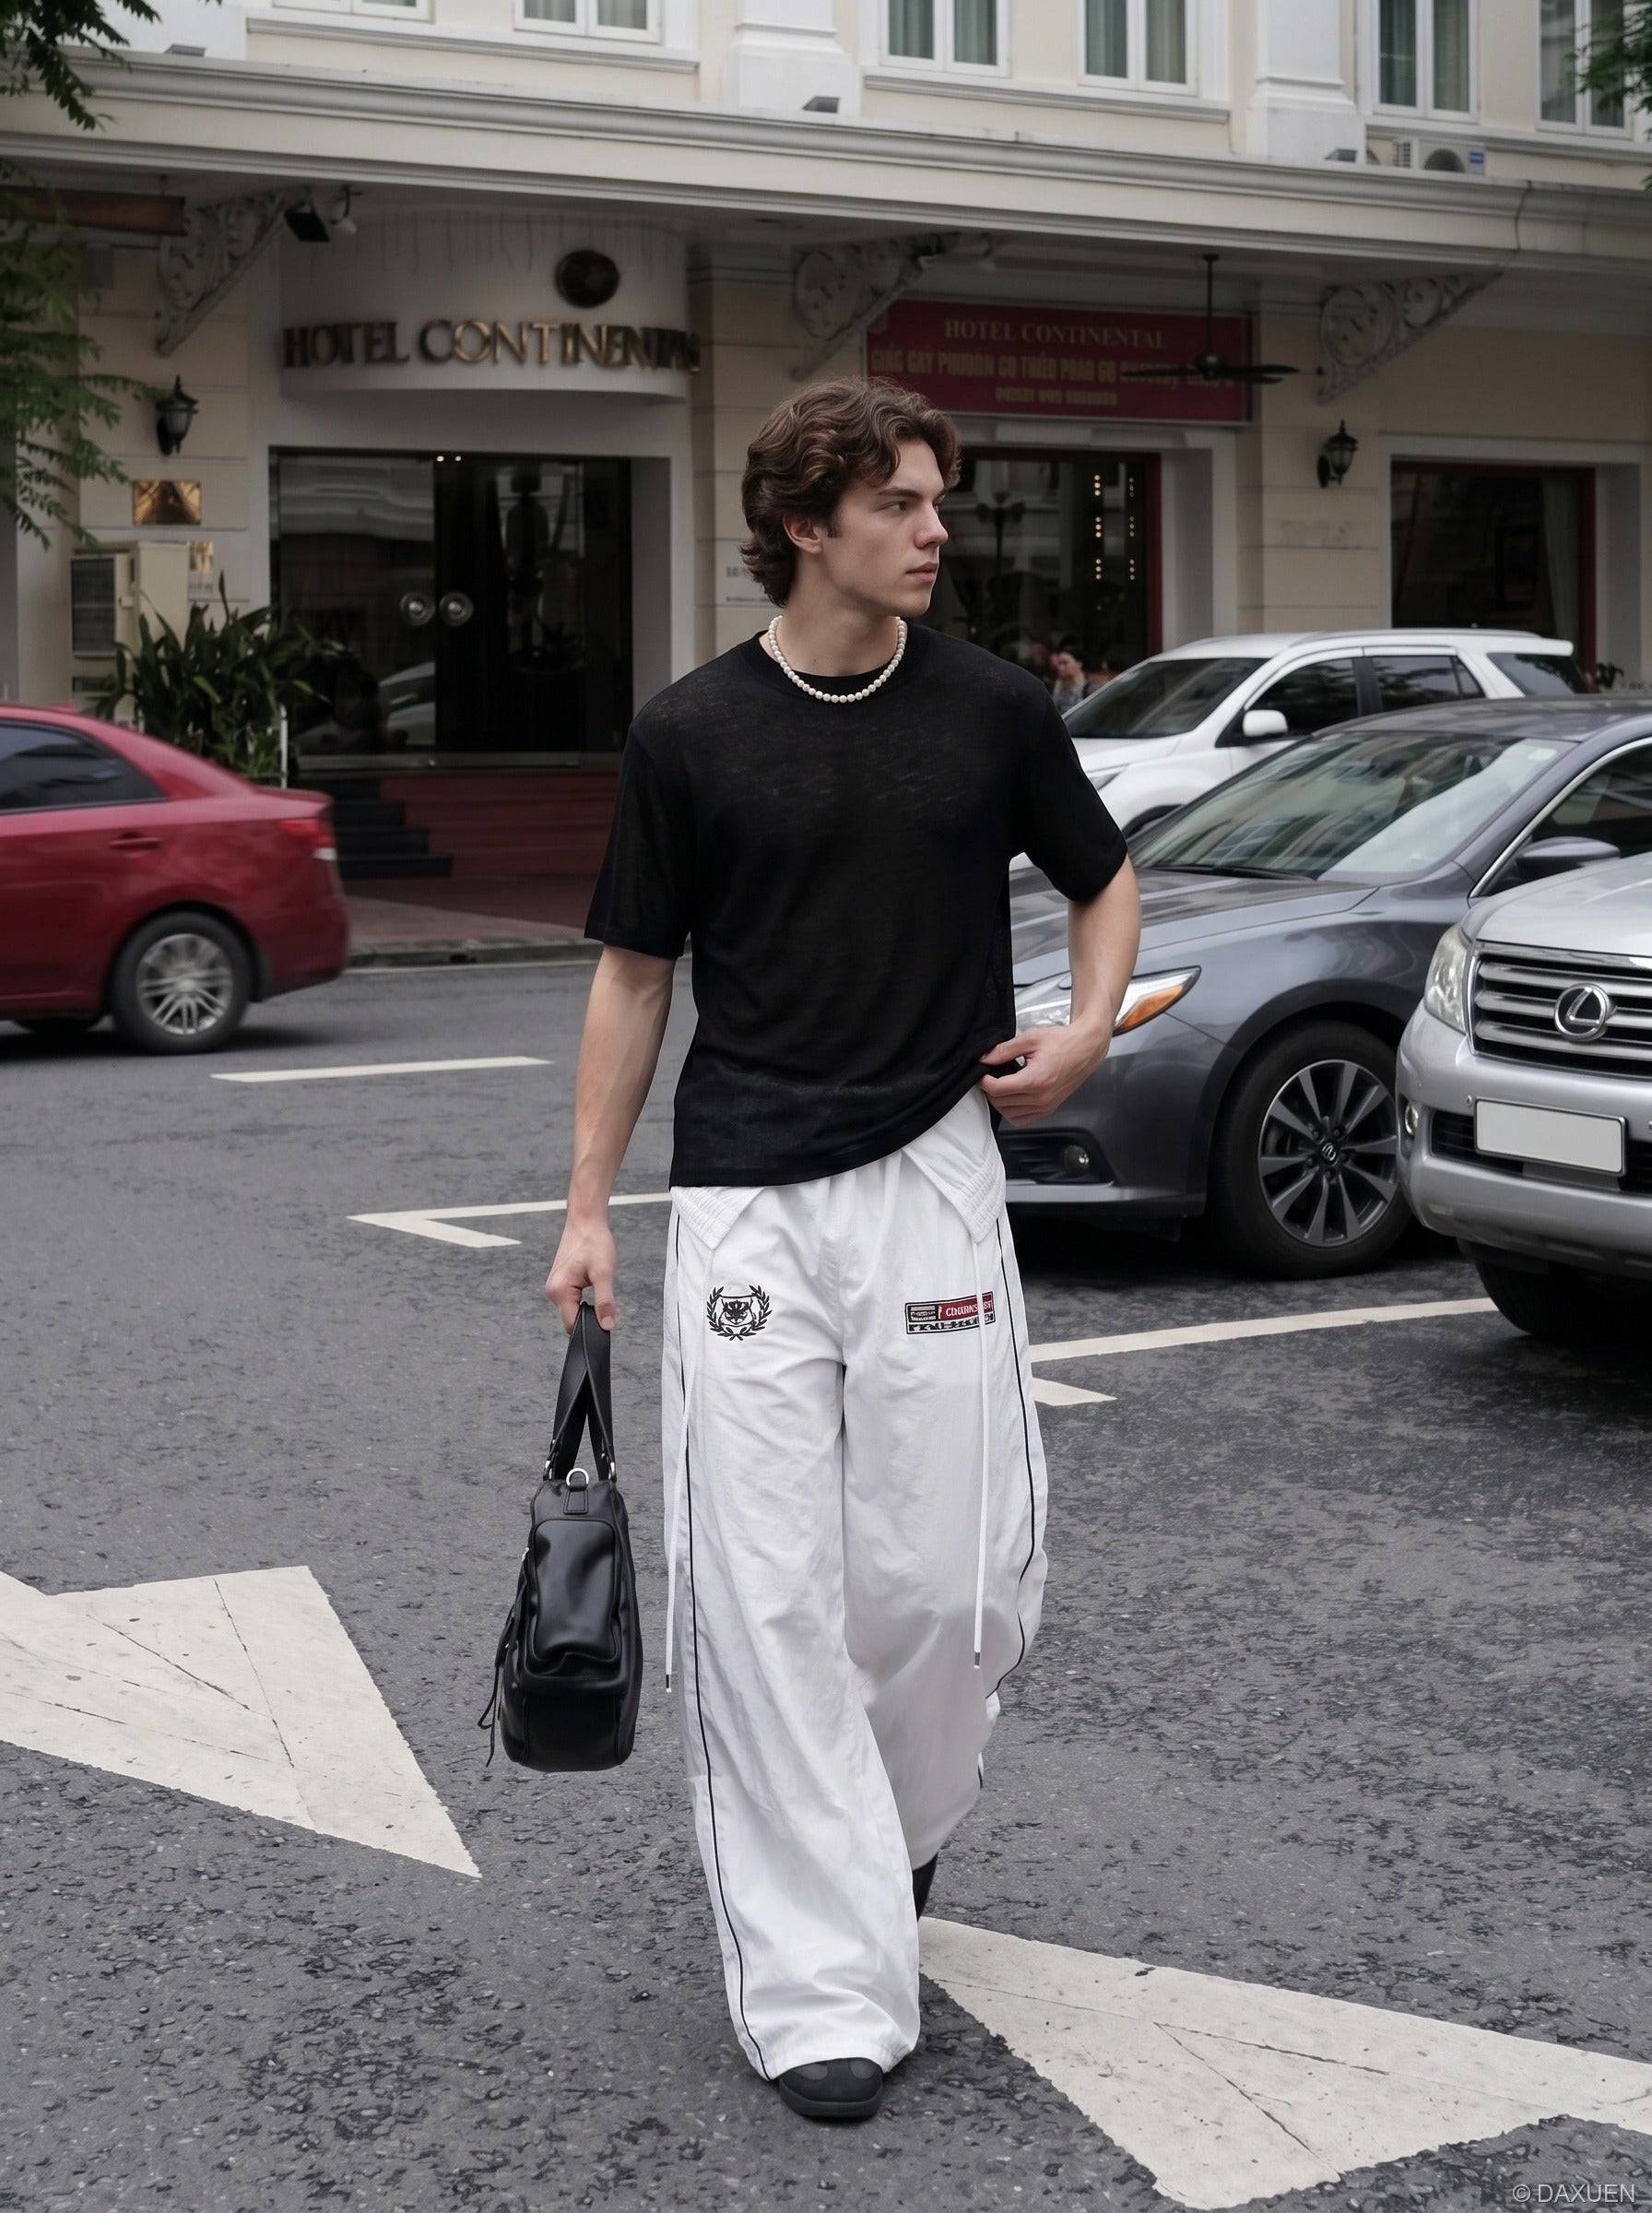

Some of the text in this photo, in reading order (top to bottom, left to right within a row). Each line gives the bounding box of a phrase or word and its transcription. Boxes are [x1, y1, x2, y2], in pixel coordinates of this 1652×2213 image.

[282, 321, 409, 368] HOTEL
[945, 319, 1168, 349] HOTEL CONTINENTAL
